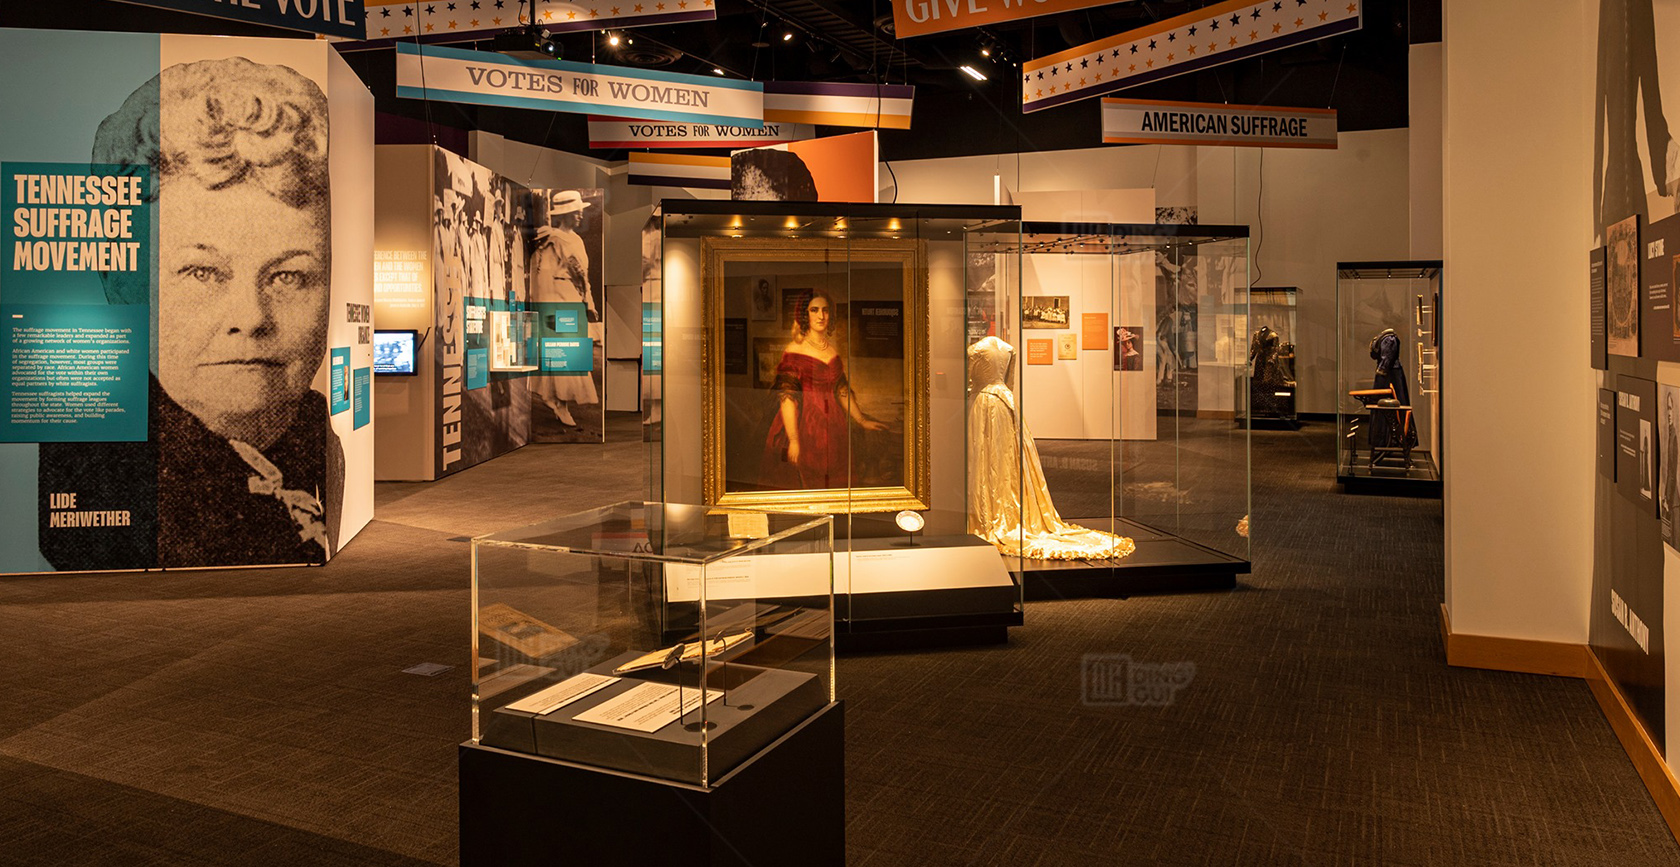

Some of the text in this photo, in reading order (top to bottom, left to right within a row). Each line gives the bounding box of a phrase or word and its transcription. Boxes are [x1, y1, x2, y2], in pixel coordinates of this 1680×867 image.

[466, 66, 710, 108] VOTES FOR WOMEN
[628, 124, 780, 137] VOTES FOR WOMEN
[1141, 111, 1308, 137] AMERICAN SUFFRAGE
[14, 174, 142, 206] TENNESSEE
[14, 207, 132, 238] SUFFRAGE
[13, 241, 140, 272] MOVEMENT
[418, 250, 427, 260] THE
[394, 262, 403, 271] THE
[50, 492, 77, 510] LIDE
[50, 510, 131, 528] MERIWETHER
